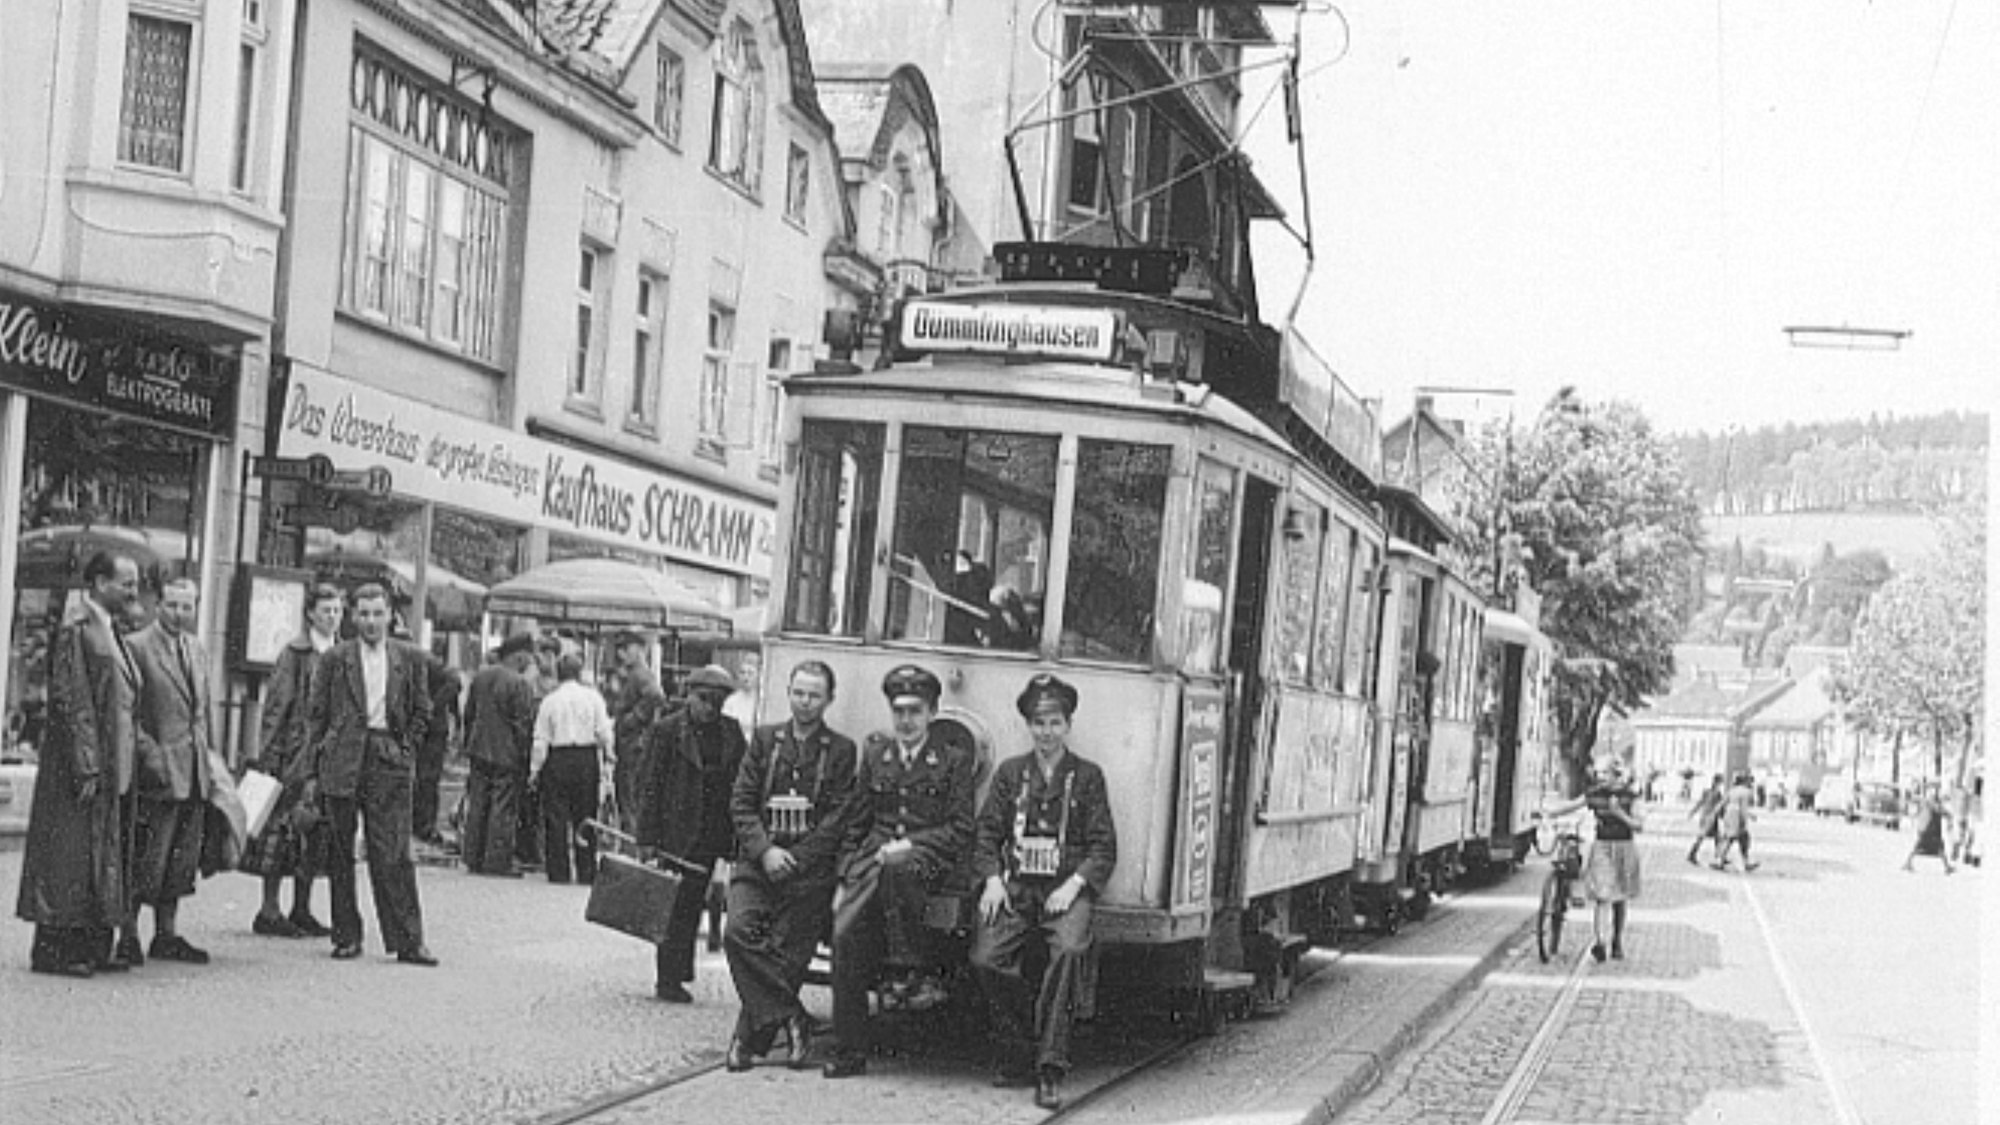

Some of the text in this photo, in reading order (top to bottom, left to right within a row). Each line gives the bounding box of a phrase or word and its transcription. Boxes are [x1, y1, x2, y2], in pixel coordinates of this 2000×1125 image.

[0, 304, 88, 383] Klein
[913, 308, 1100, 348] Dümmlinghausen
[543, 453, 634, 535] Kaufhaus
[640, 483, 754, 566] SCHRAMM
